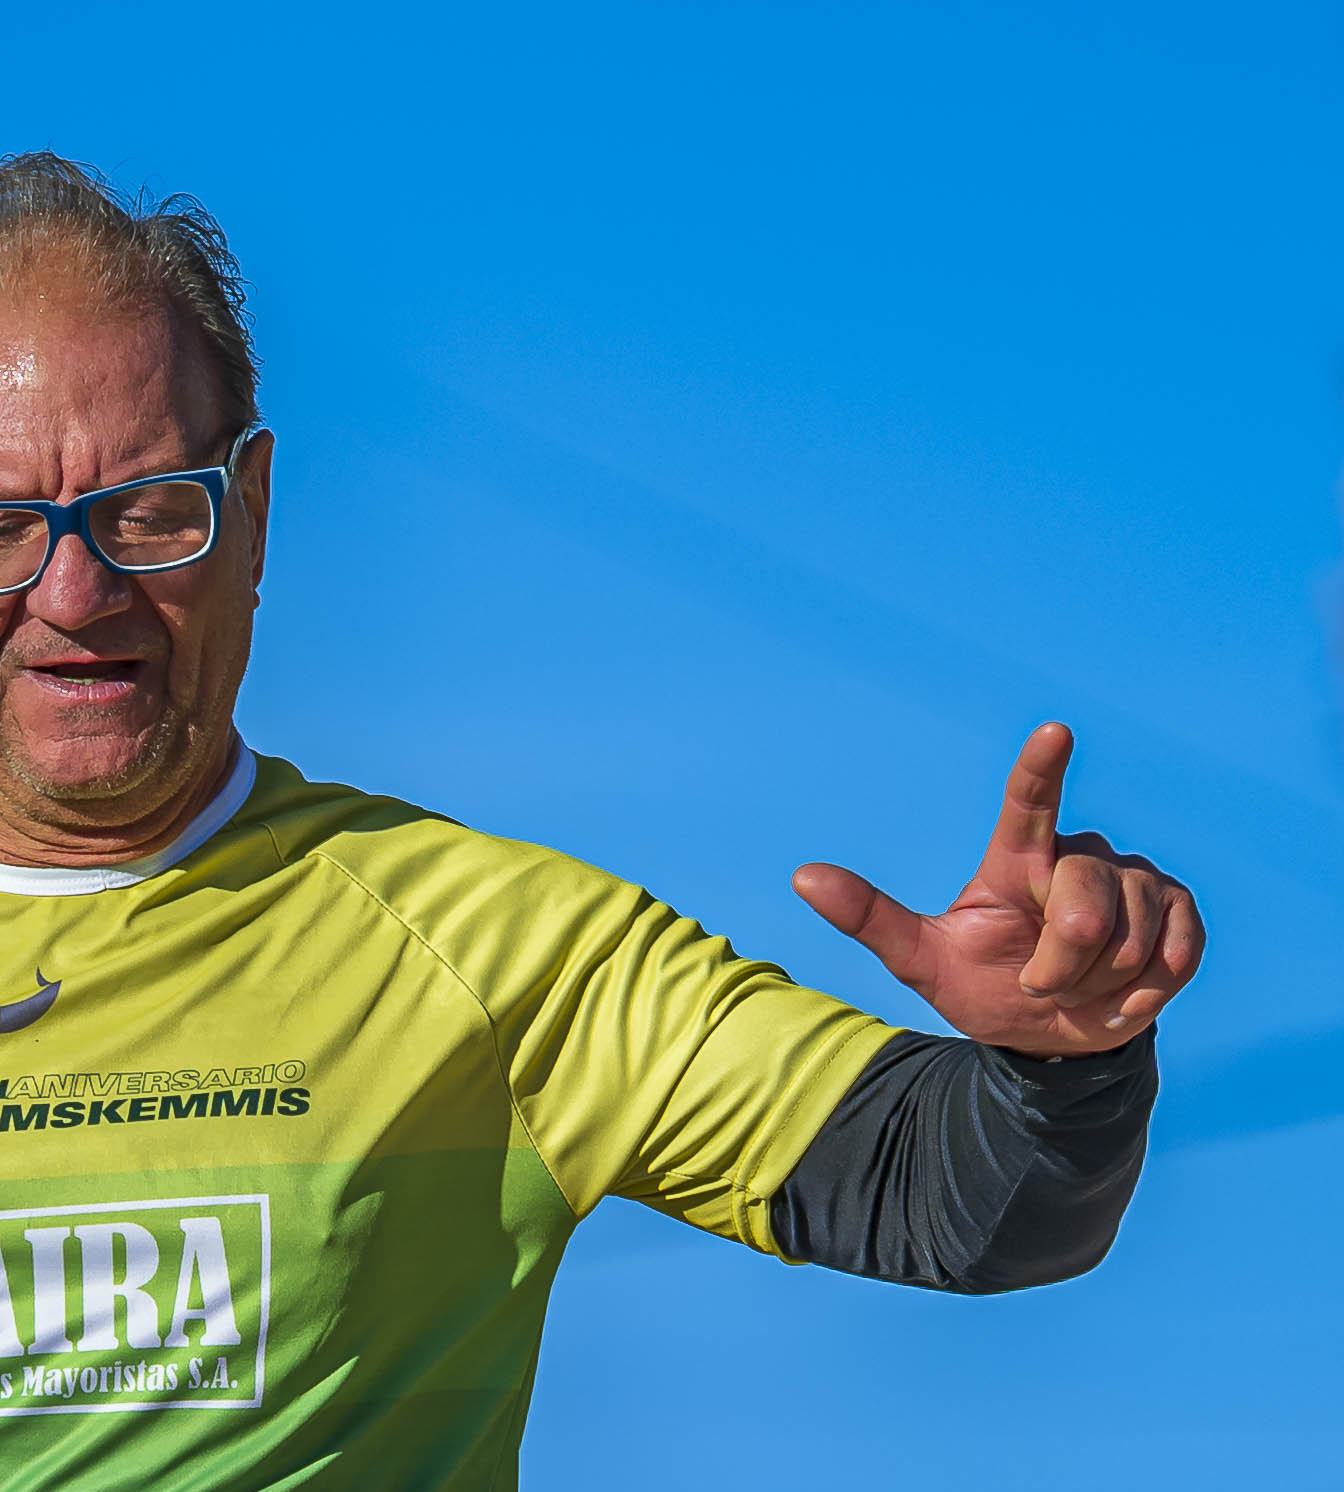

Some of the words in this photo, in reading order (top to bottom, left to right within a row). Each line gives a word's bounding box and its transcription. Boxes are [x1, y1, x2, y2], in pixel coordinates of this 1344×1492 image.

[7, 1059, 306, 1100] ANIVERSARIO
[21, 1360, 179, 1400] Mayoristas
[187, 1356, 239, 1390] S.A.
